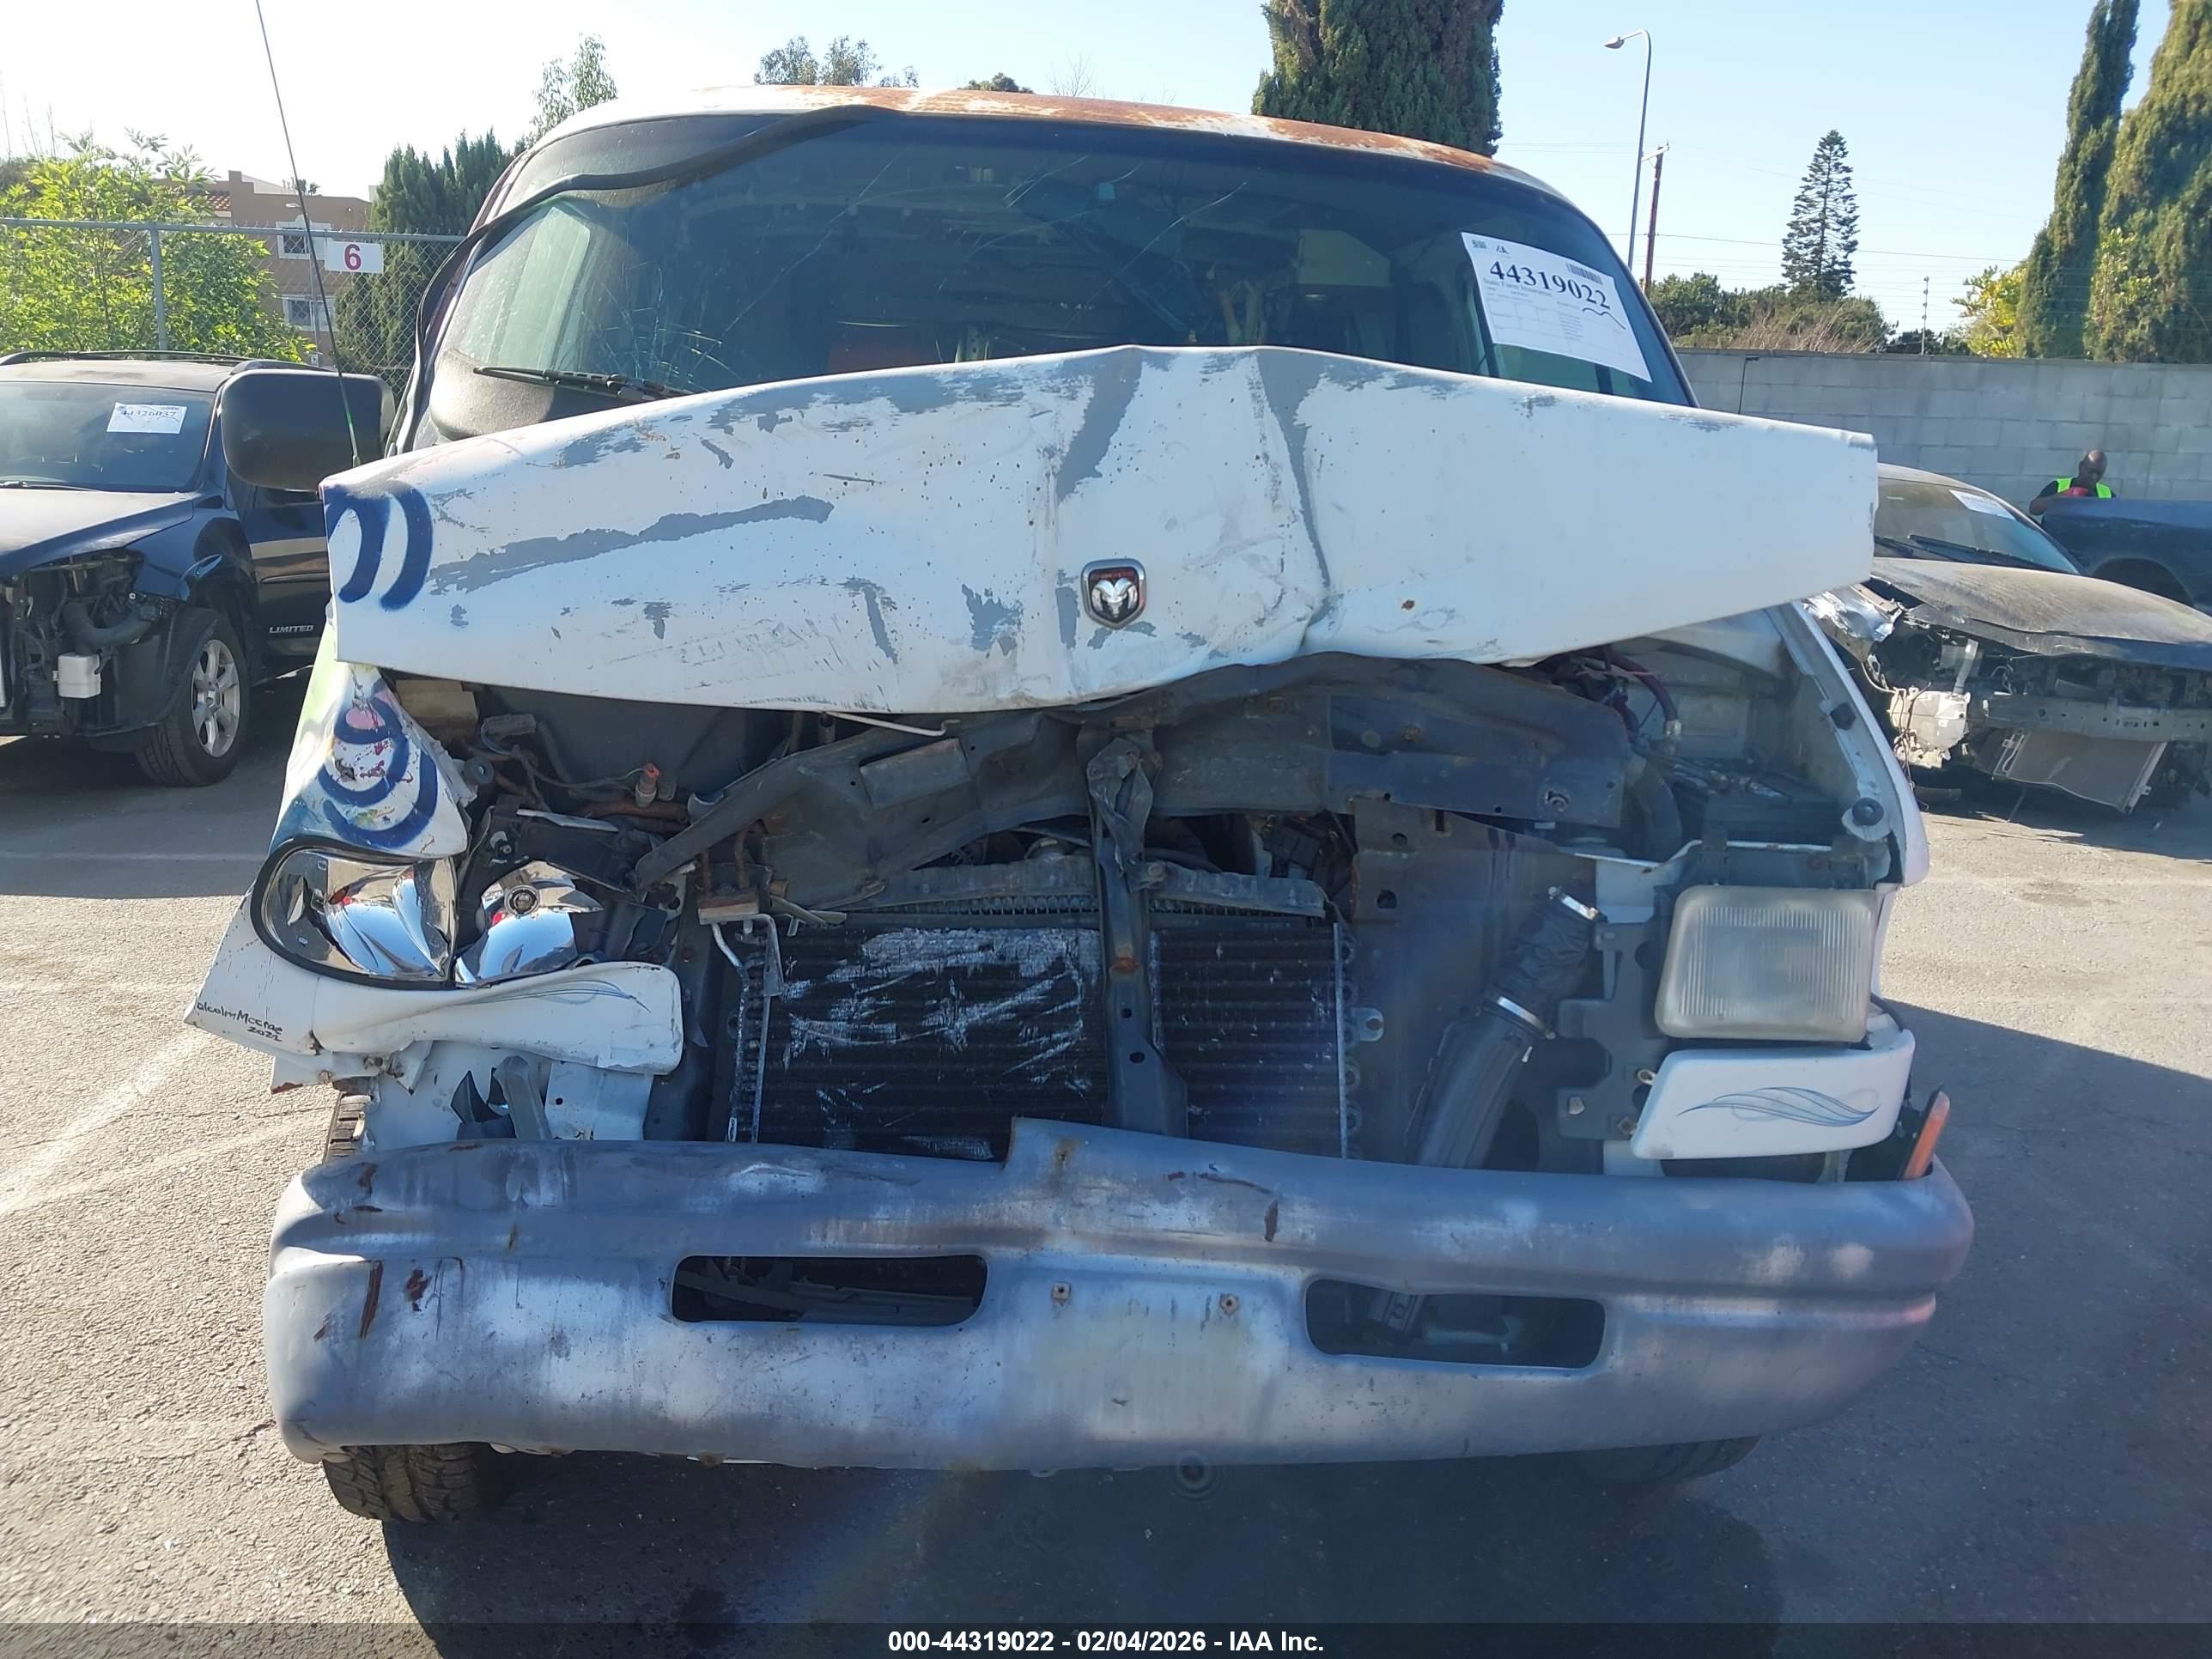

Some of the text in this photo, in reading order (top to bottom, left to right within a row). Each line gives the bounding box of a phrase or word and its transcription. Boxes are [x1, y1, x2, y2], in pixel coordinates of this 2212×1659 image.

[344, 244, 362, 270] 6
[1490, 260, 1611, 310] 44319022
[269, 625, 314, 634] LIMITED
[197, 1001, 237, 1020] alcolm
